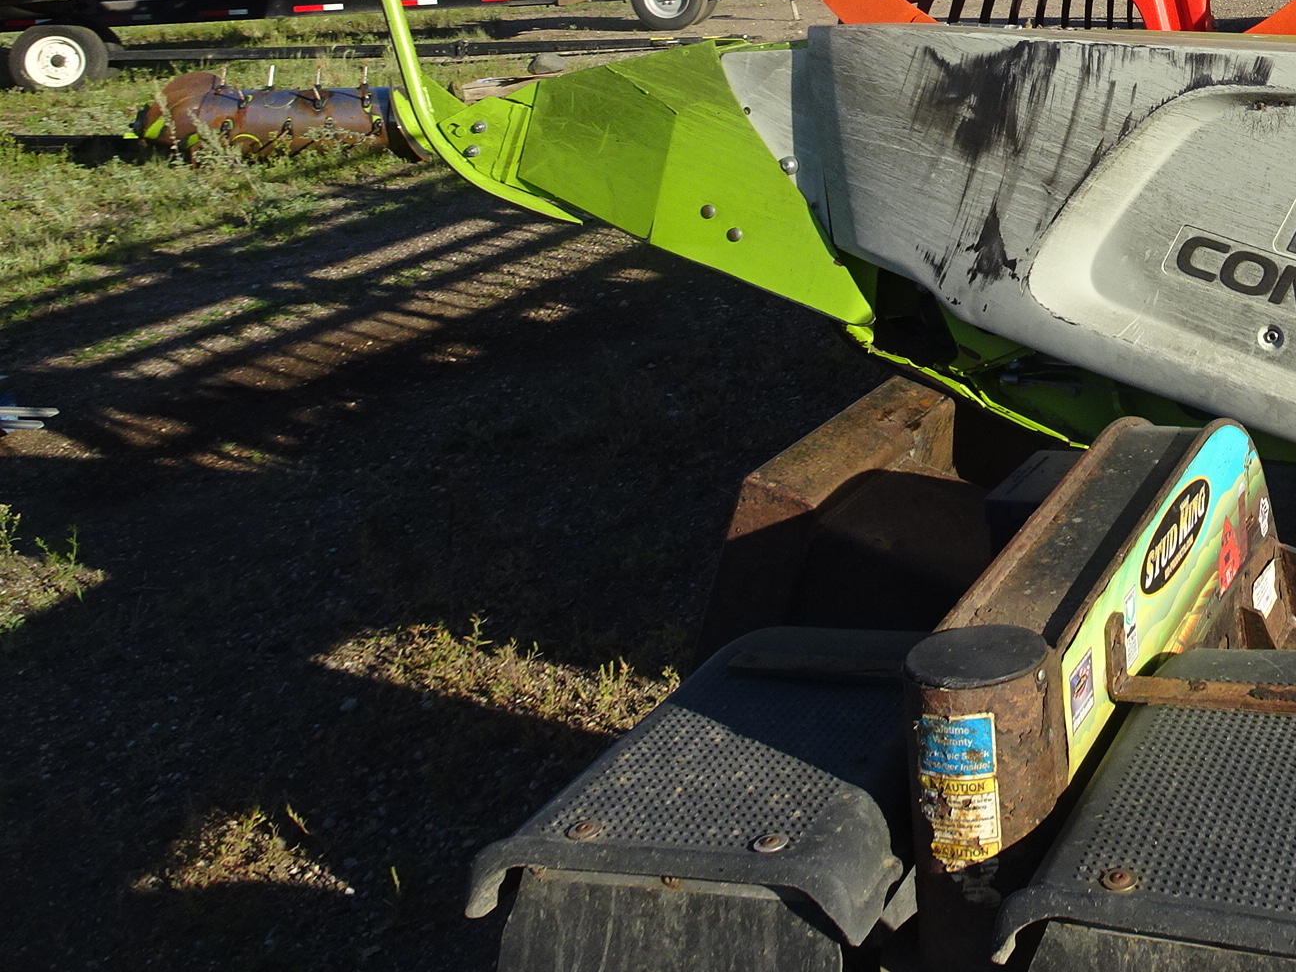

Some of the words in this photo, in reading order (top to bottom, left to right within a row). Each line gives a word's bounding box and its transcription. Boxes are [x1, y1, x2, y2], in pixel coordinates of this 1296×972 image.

[1145, 522, 1179, 590] STUD
[1179, 482, 1206, 545] KING
[941, 781, 986, 794] AUTION
